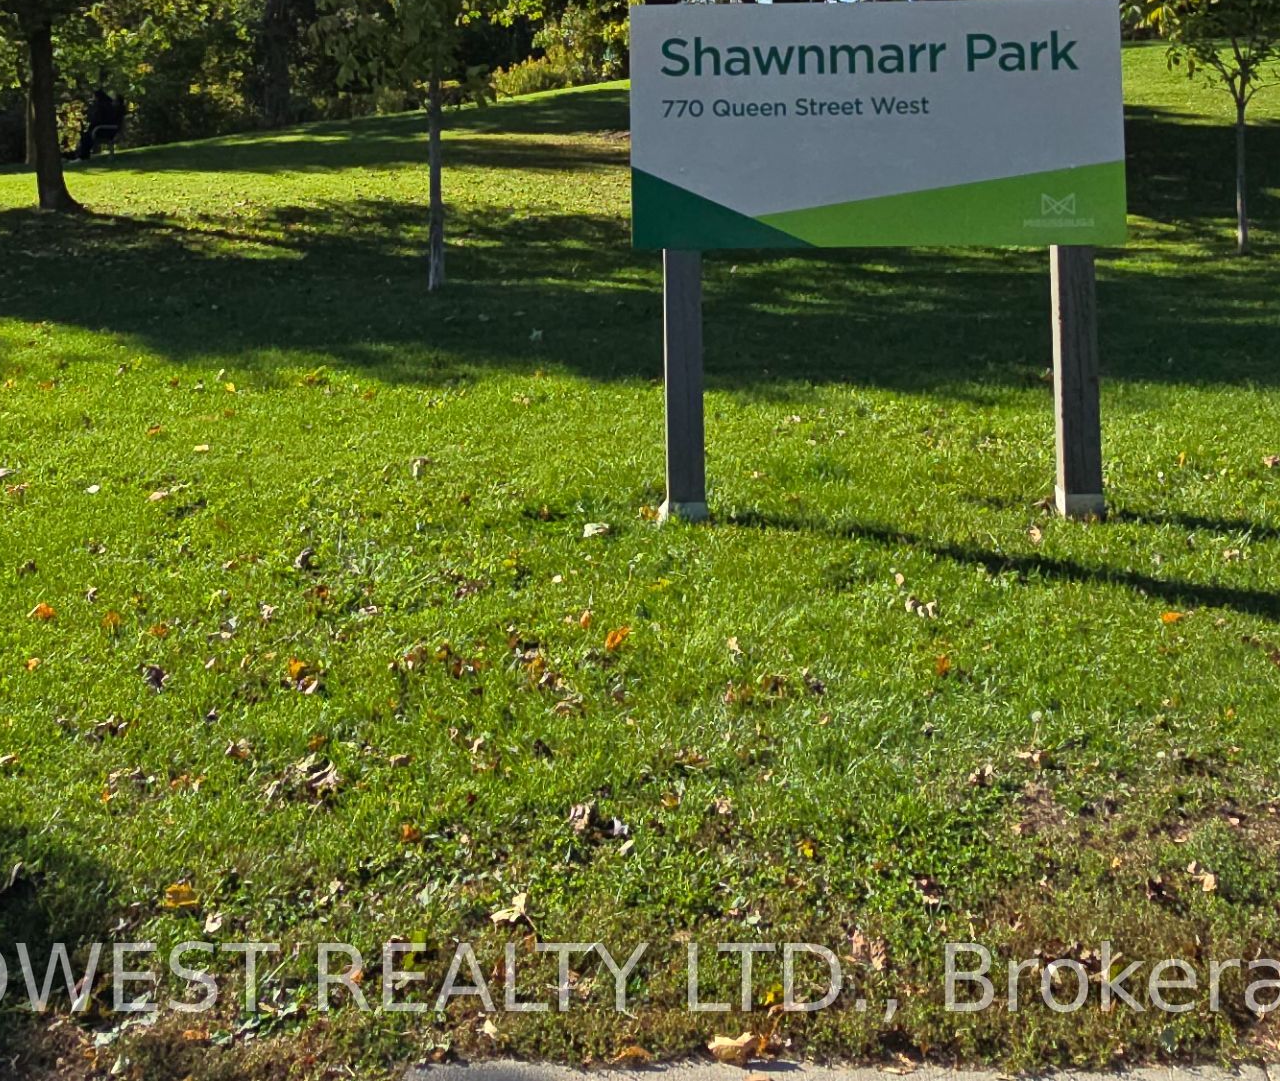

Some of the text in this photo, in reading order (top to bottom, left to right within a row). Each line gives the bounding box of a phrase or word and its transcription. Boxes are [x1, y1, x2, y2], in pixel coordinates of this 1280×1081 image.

[660, 30, 1078, 77] Shawnmarr Park
[662, 96, 929, 118] 770 Queen Street West
